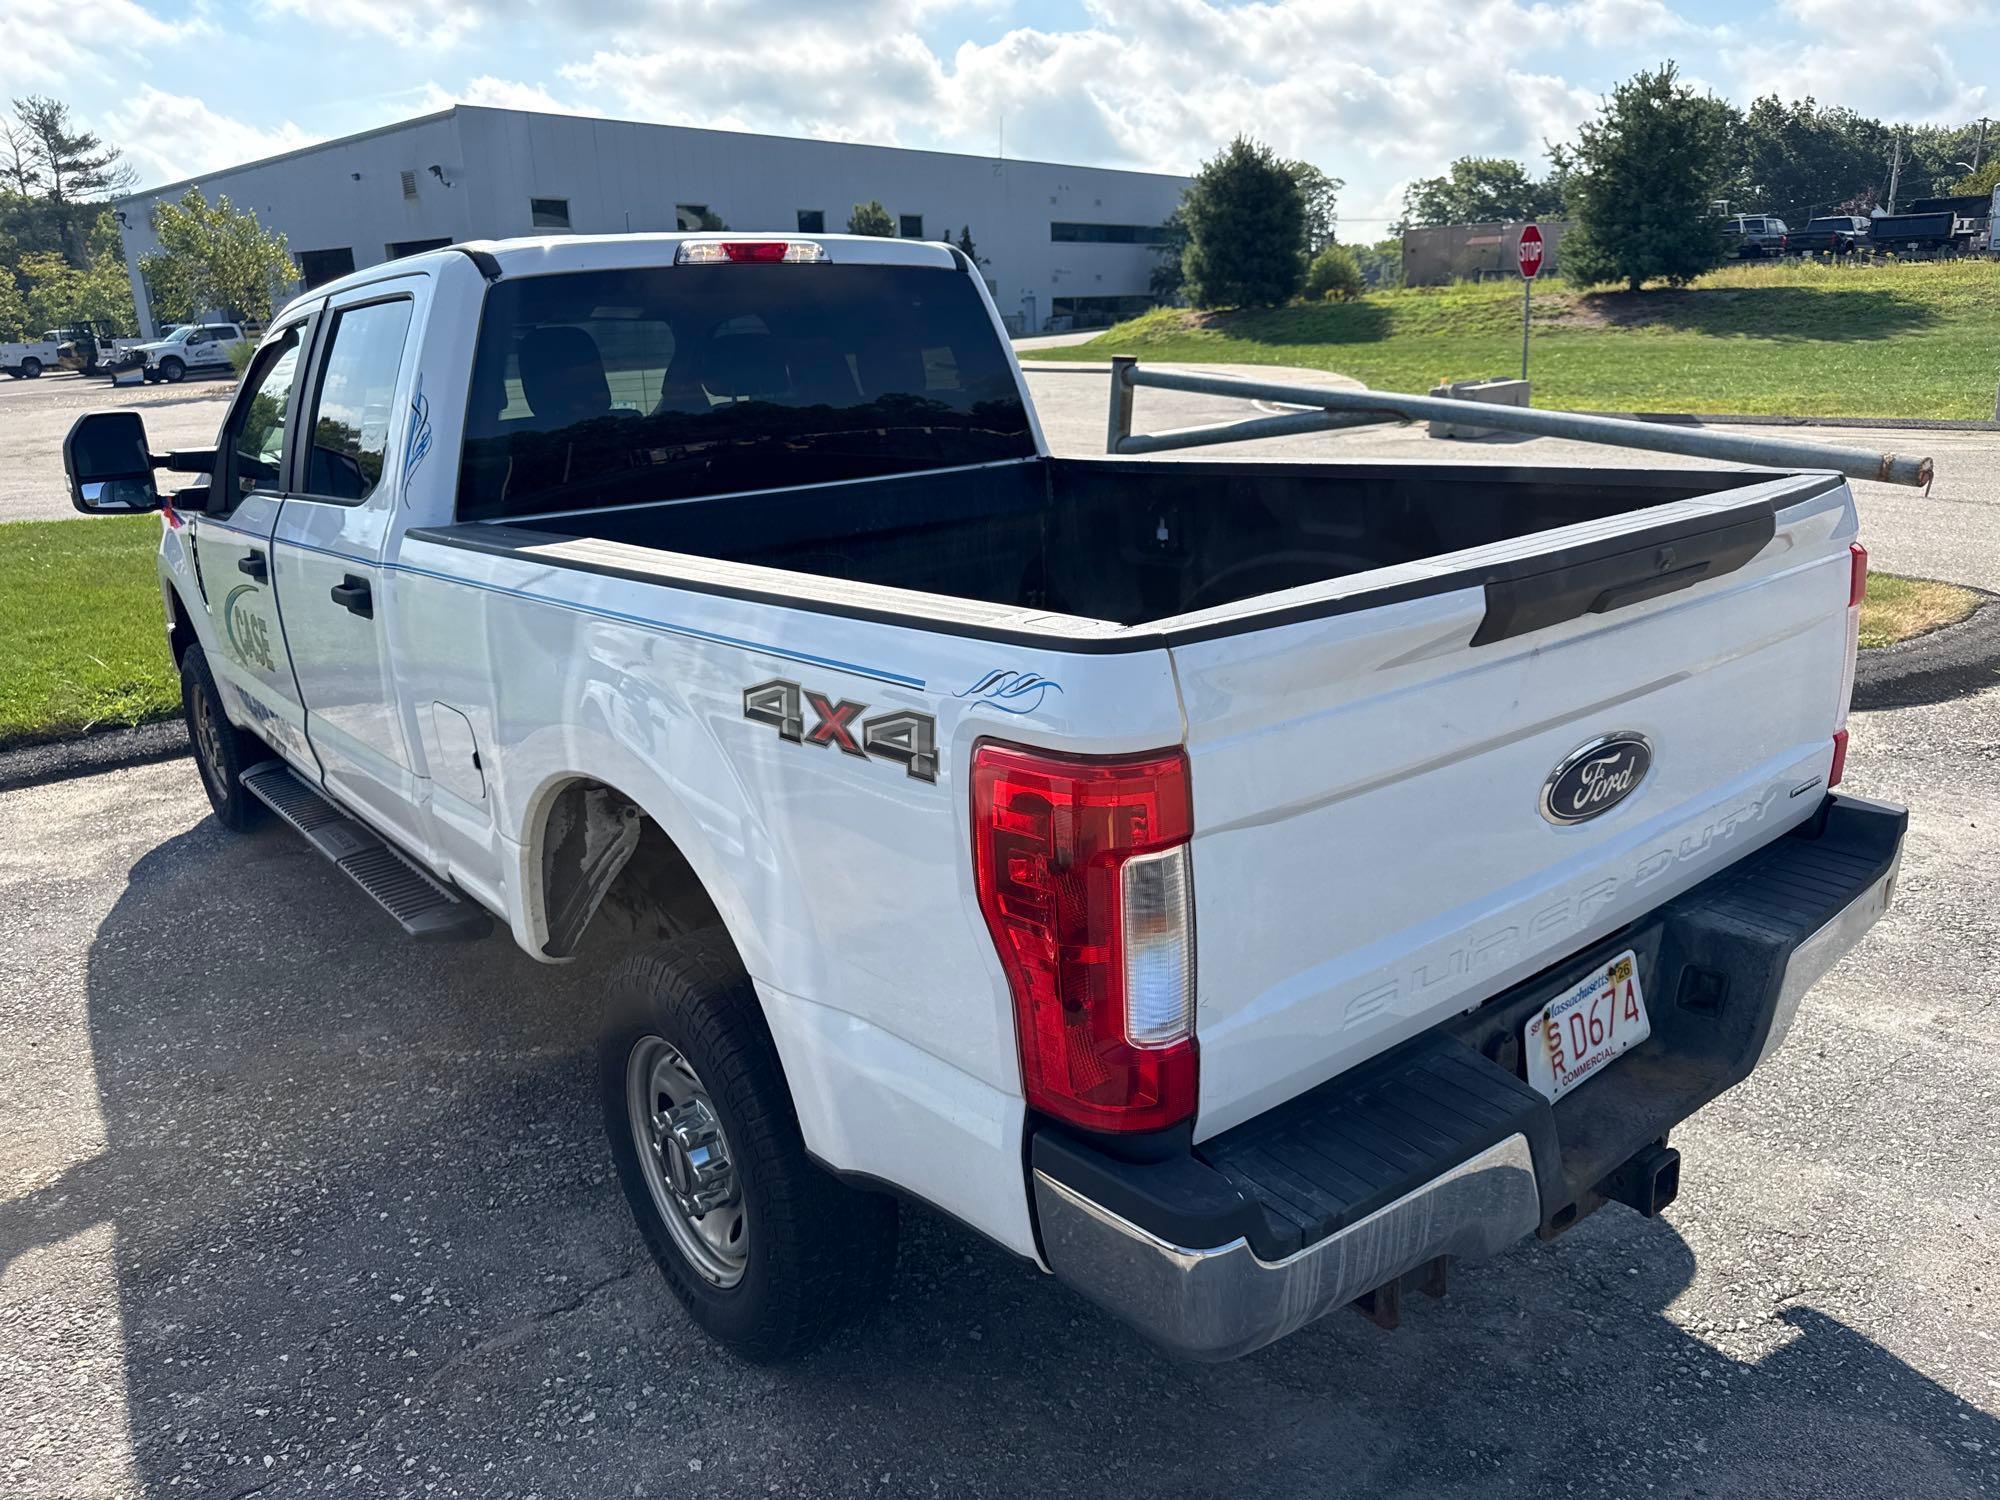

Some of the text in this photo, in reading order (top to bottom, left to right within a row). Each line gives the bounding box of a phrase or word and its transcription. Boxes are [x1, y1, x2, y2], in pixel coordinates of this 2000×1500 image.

[1520, 241, 1541, 262] STOP
[1573, 752, 1635, 809] Ford
[1342, 790, 1778, 1032] SUPER DUTY
[1617, 962, 1631, 981] 26
[1561, 1045, 1617, 1087] COMMERCIAL
